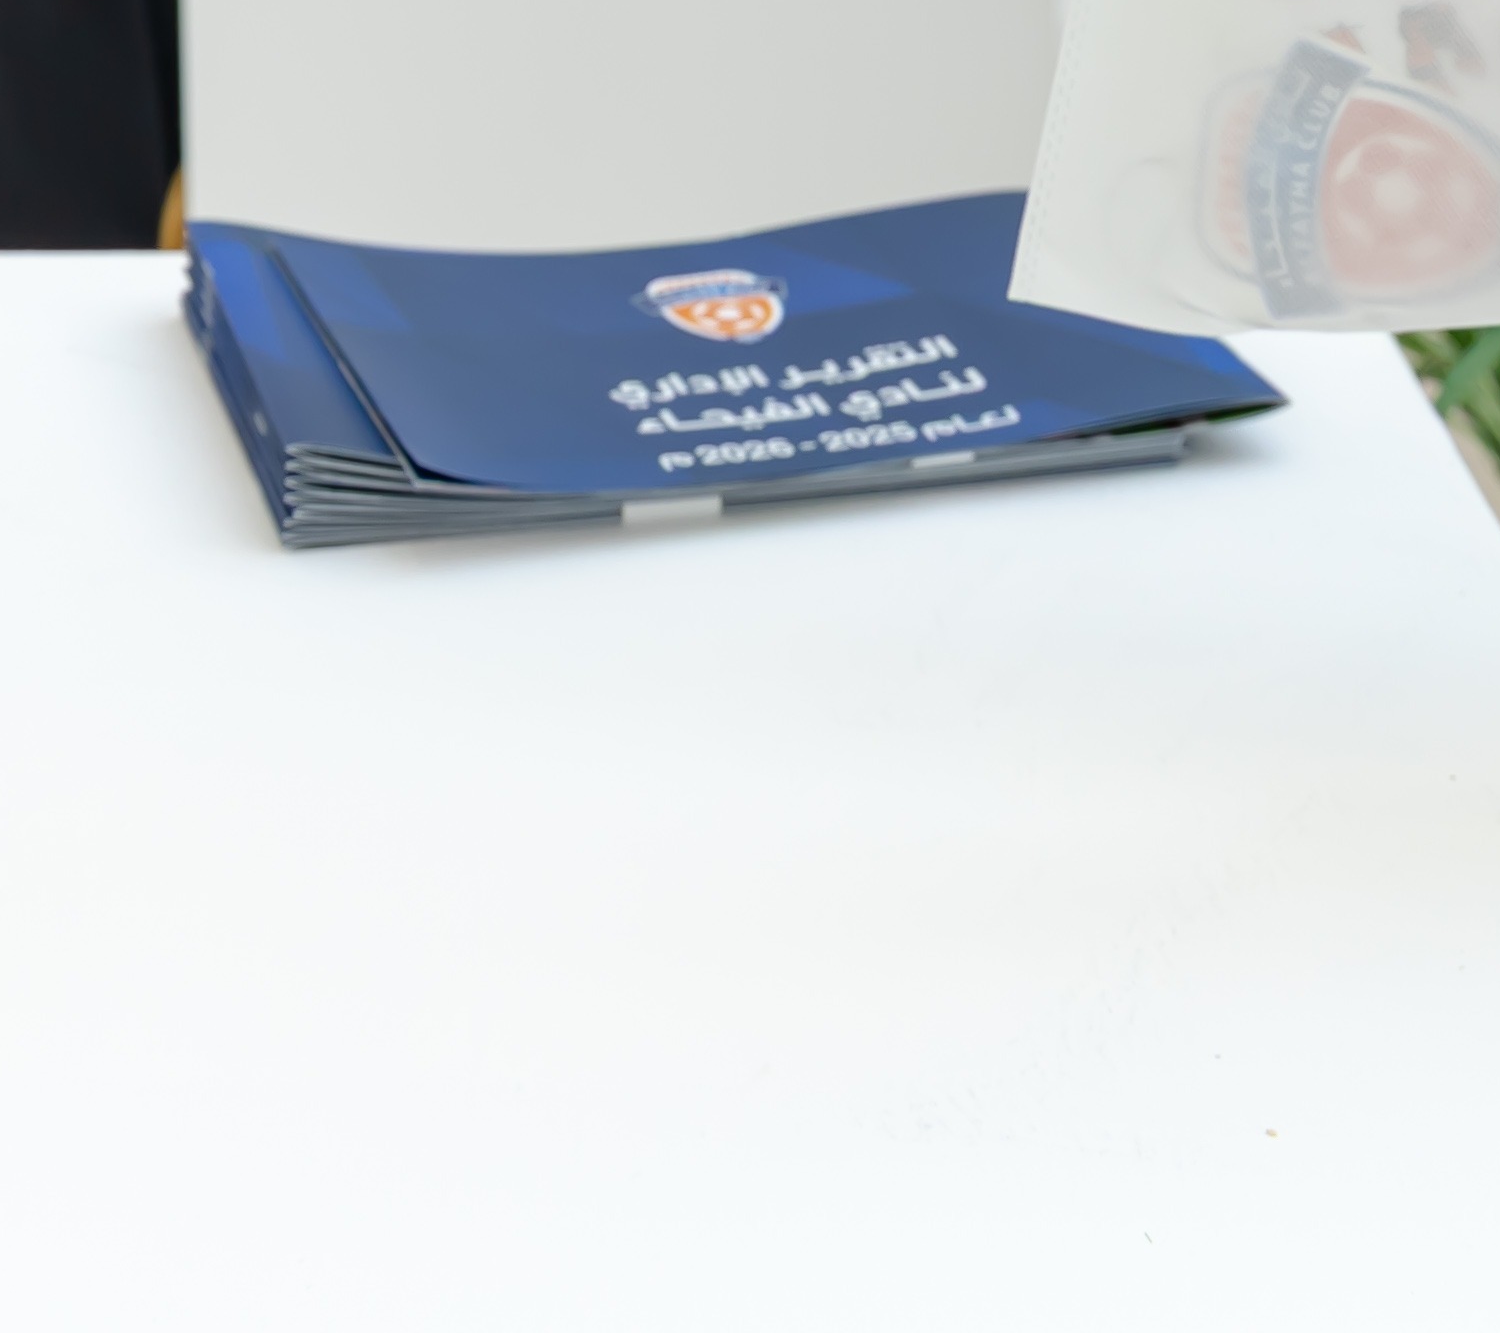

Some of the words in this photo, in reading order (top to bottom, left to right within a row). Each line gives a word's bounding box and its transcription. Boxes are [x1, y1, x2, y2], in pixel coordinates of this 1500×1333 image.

[608, 364, 770, 412] الإداري
[778, 334, 959, 391] التقرير
[636, 392, 832, 436] الفيحاء
[839, 366, 988, 422] لنادي
